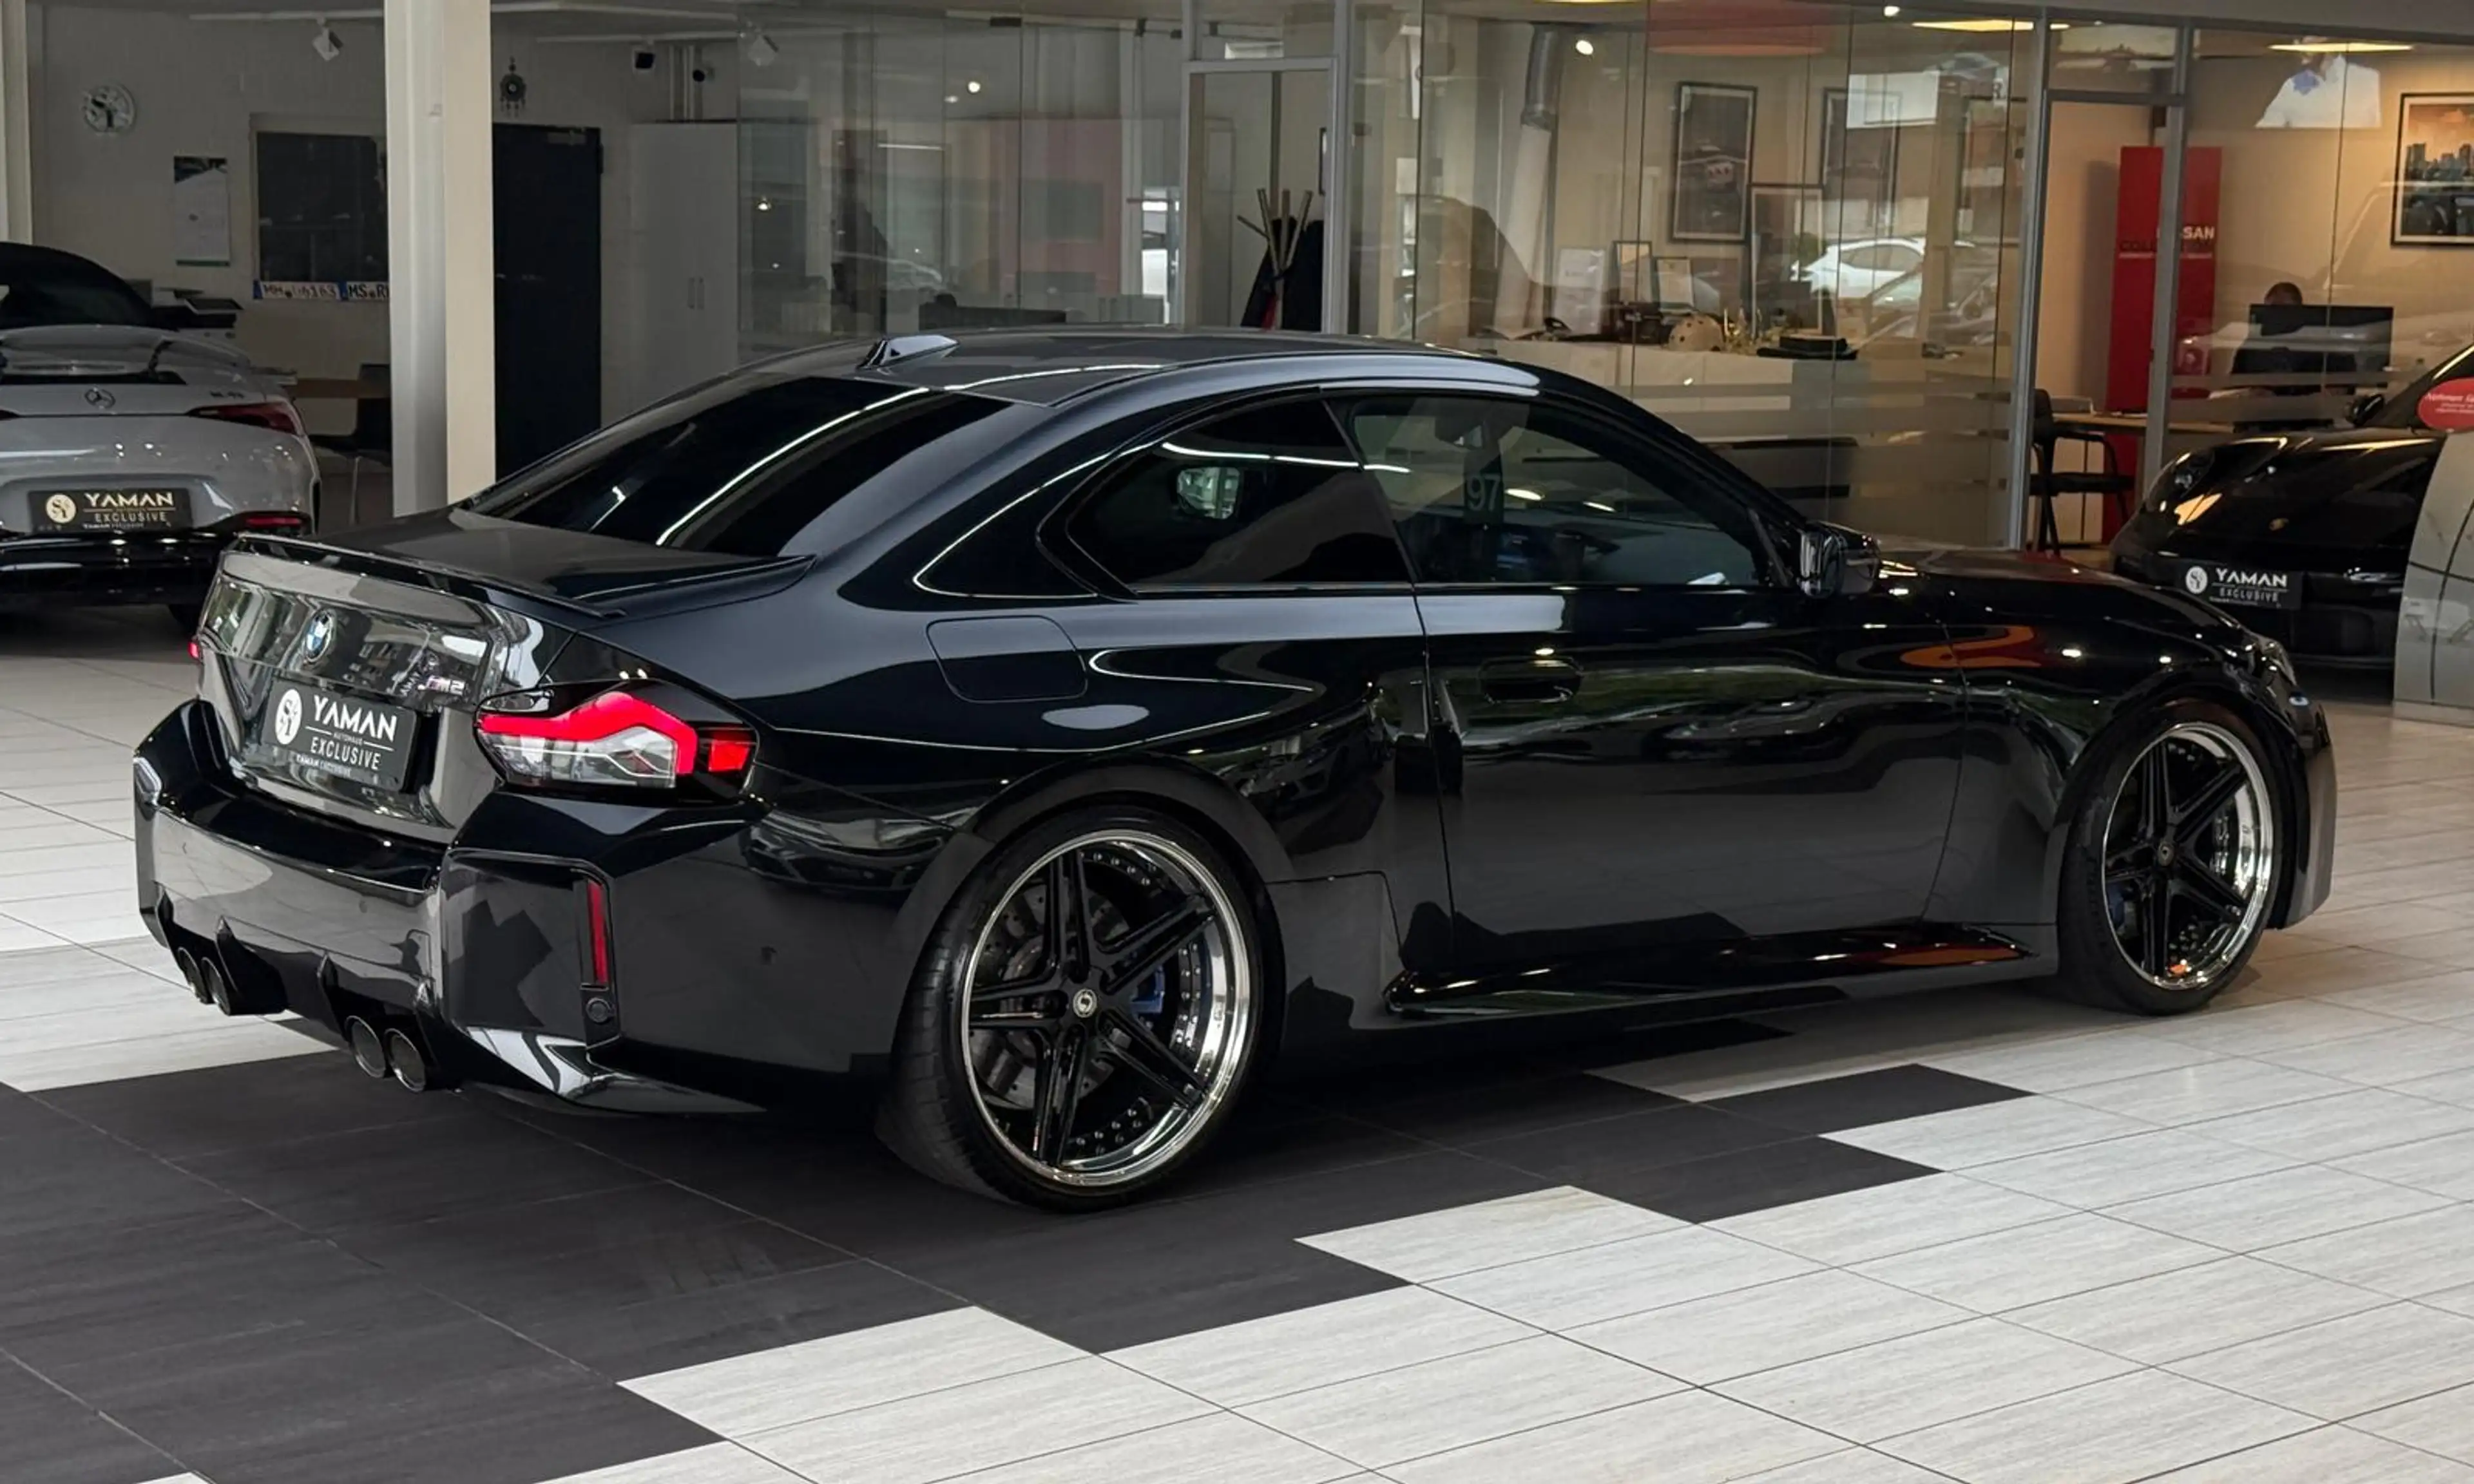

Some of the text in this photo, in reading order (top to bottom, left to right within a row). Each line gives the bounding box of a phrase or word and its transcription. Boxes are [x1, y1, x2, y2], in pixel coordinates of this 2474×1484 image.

[84, 492, 174, 508] YAMAN
[95, 512, 168, 522] EXCLUSIVE
[2216, 567, 2287, 587] YAMAN
[2220, 587, 2279, 603] EXCLUSIVE
[313, 694, 397, 742] YAMAN
[311, 736, 381, 771] EXCLUSIVE
